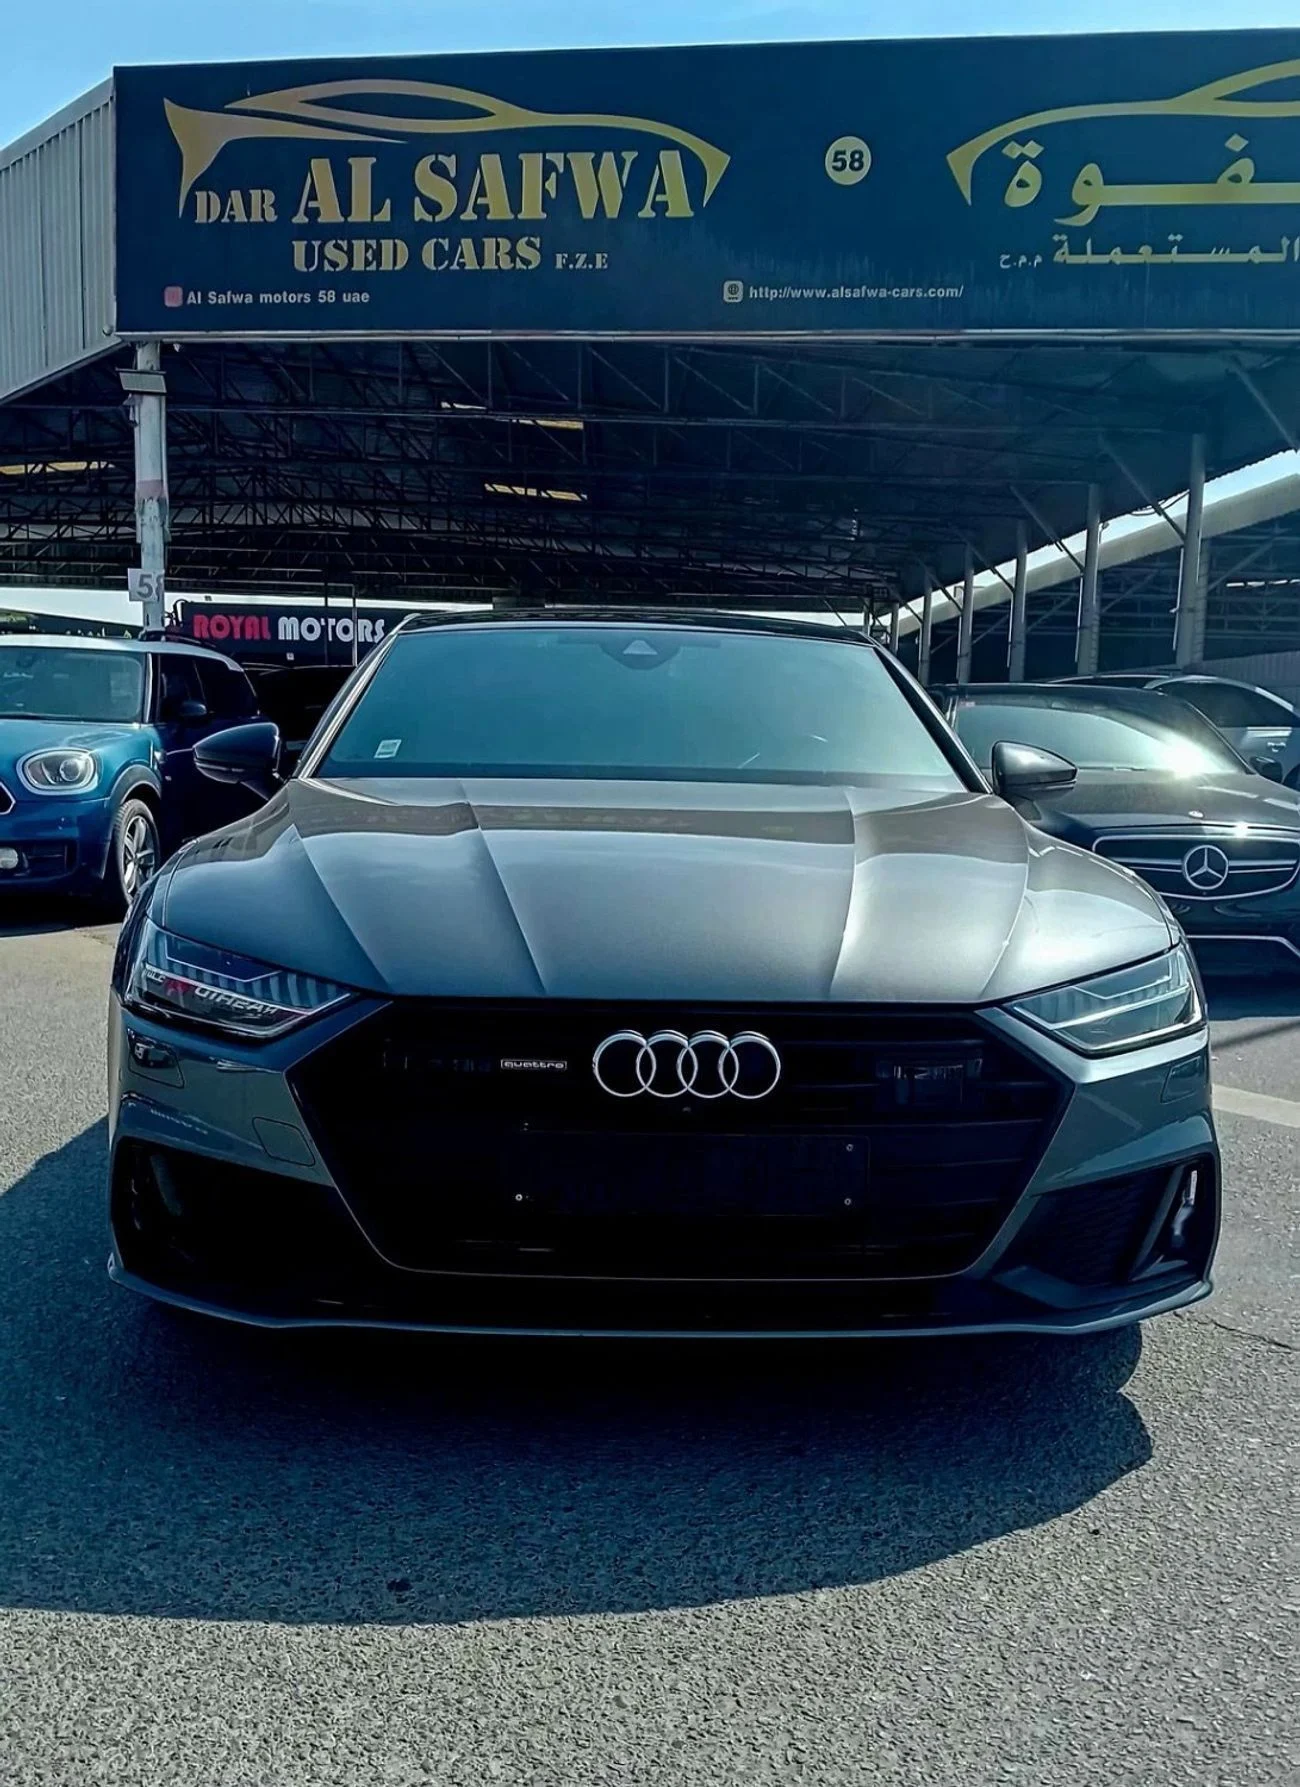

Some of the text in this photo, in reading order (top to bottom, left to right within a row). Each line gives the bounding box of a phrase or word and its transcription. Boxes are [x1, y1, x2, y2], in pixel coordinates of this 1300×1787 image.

[831, 149, 865, 172] 58
[195, 149, 696, 224] DAR AL SAFWA
[292, 236, 609, 273] USED CARS F.Z.E
[186, 289, 370, 304] Al Safwa motors 58 uae
[749, 285, 964, 300] http://www.alsafwa-cars.com/
[193, 614, 385, 643] ROYAL MOTORS
[504, 1061, 564, 1069] quattro
